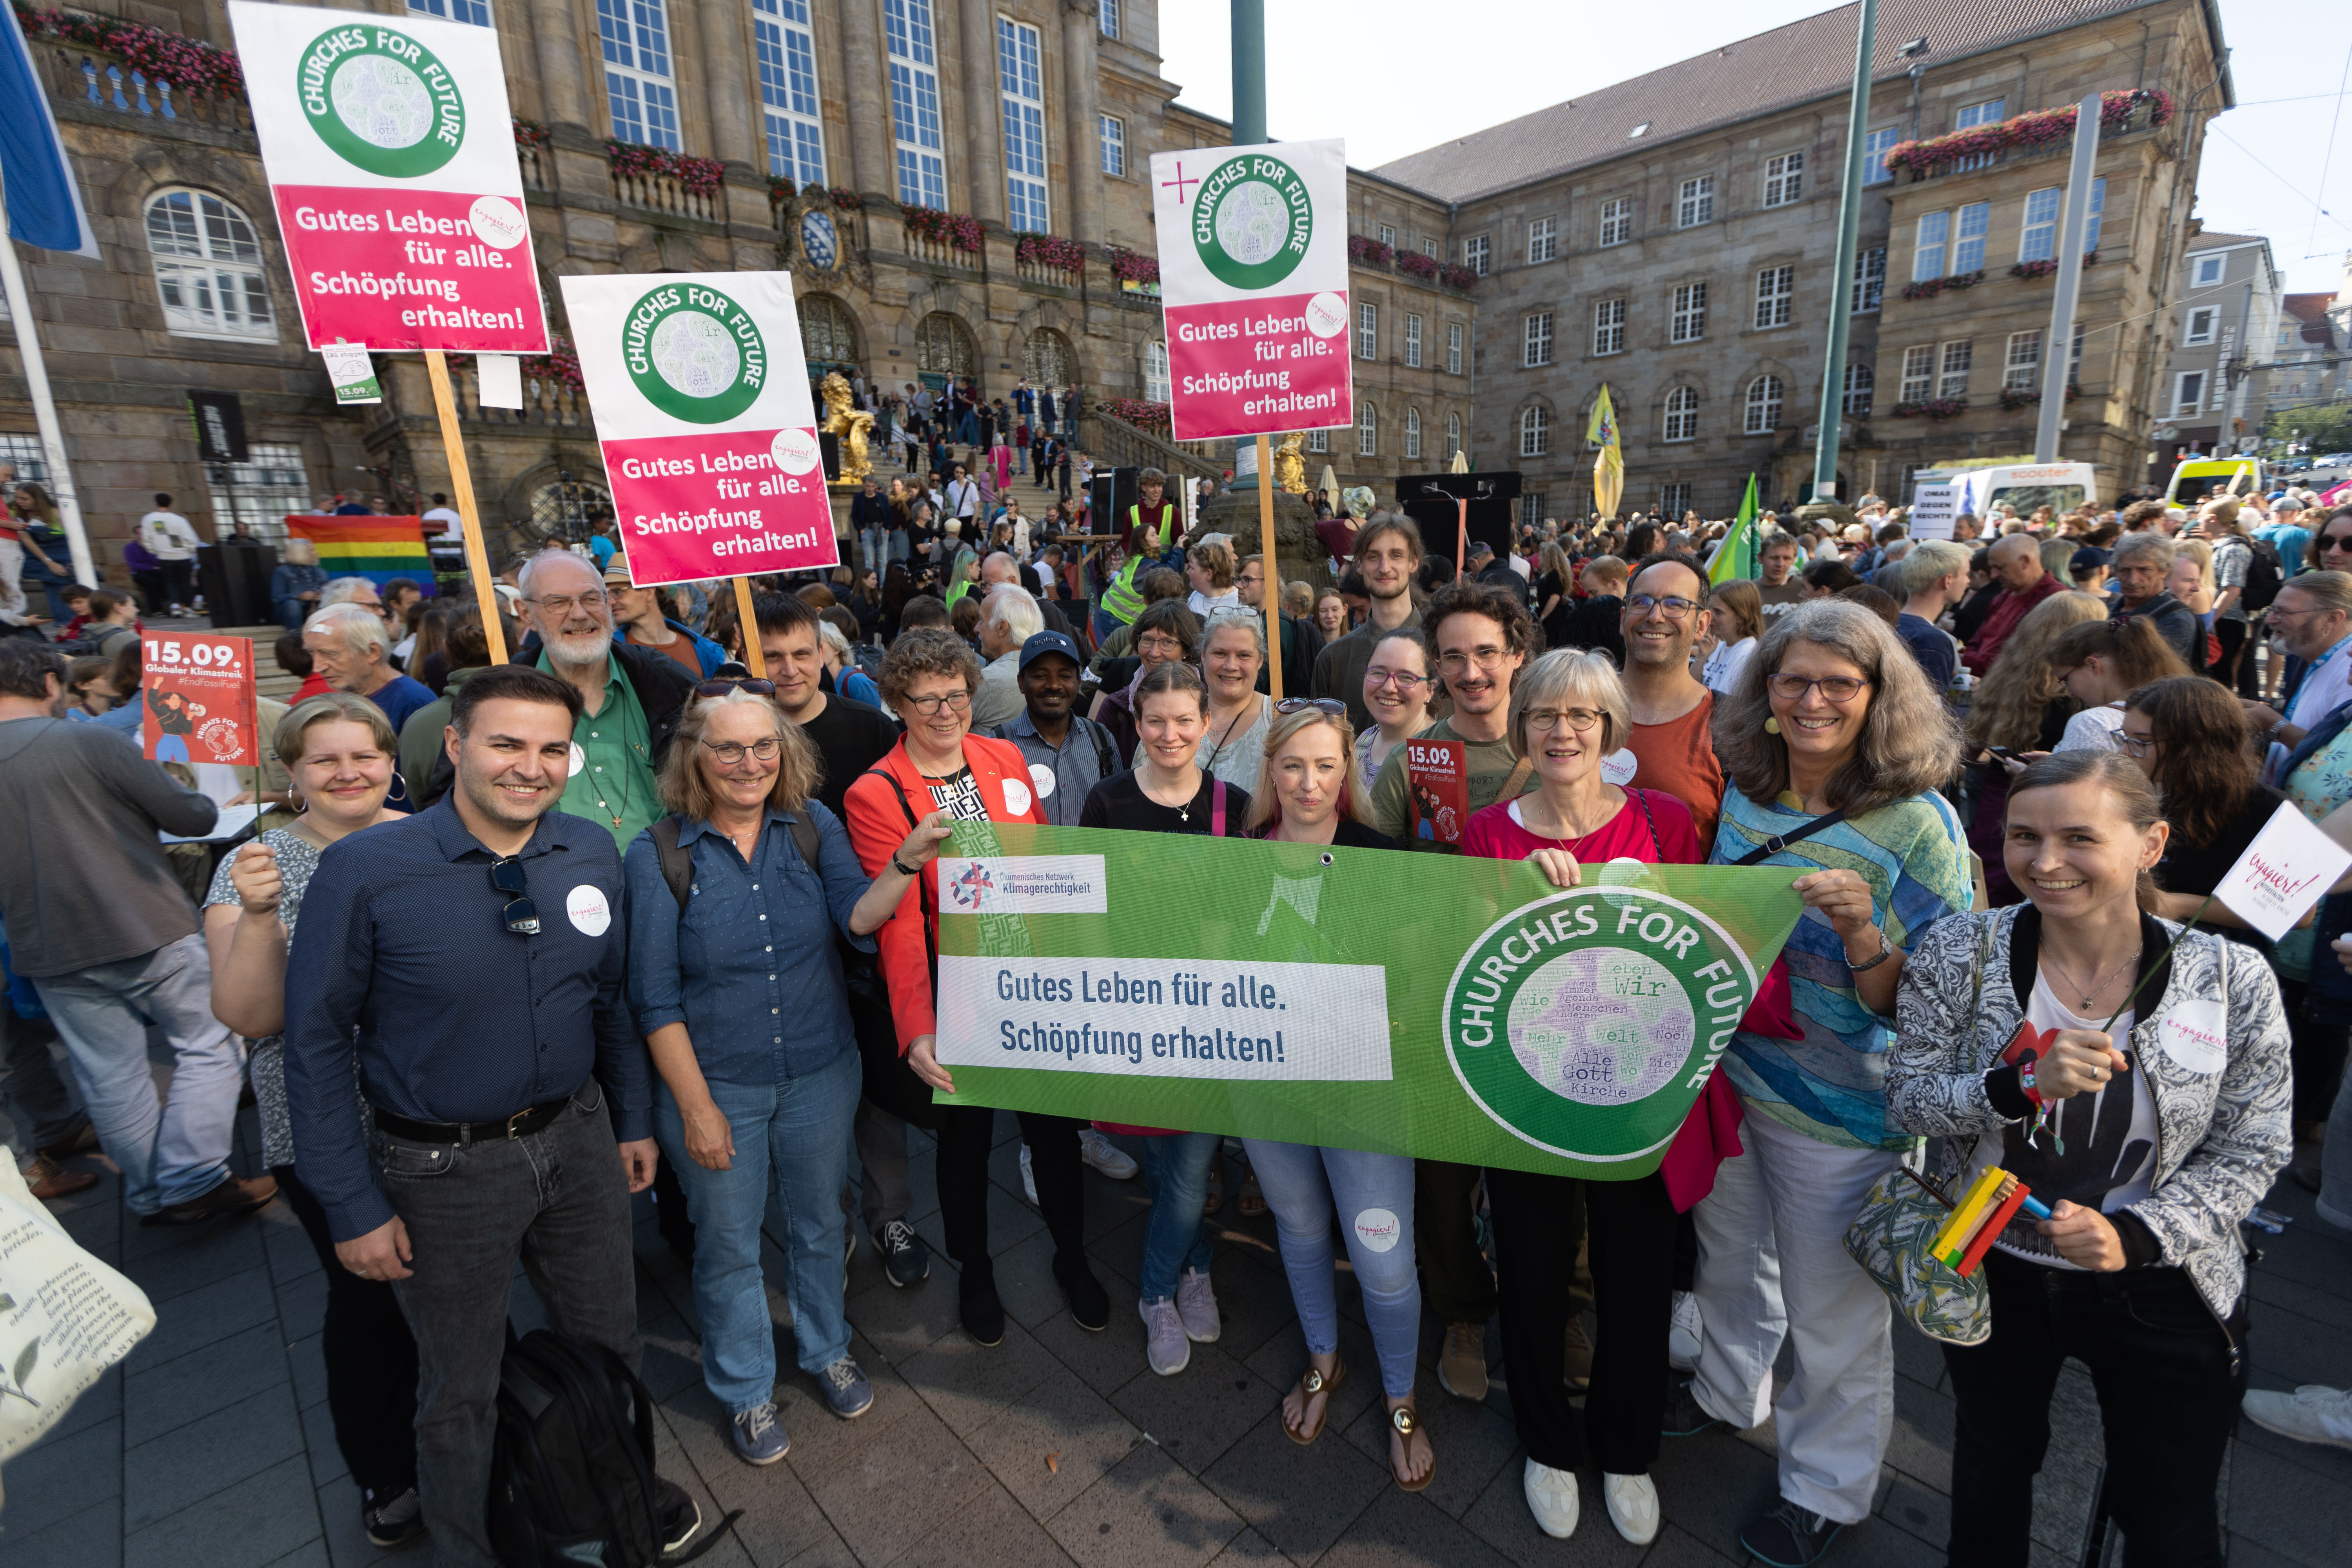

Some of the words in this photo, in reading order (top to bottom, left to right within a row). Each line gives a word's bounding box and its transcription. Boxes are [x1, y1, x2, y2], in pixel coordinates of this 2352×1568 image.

[304, 29, 367, 115] CHURCHES
[377, 31, 421, 64] FOR
[423, 63, 461, 147] FUTURE
[1197, 160, 1247, 244] CHURCHES
[1253, 158, 1287, 185] FOR
[1285, 180, 1309, 255] FUTURE
[1256, 195, 1276, 205] Wir
[296, 207, 379, 231] Gutes
[386, 210, 472, 236] Leben
[475, 208, 522, 233] engagiert!
[404, 240, 446, 265] für
[456, 244, 512, 268] alle.
[310, 271, 460, 302] Schöpfung
[402, 304, 524, 329] erhalten!
[1312, 302, 1344, 325] engagiert!
[628, 288, 681, 374] CHURCHES
[688, 288, 728, 316] FOR
[730, 313, 764, 388] FUTURE
[696, 326, 720, 337] Wir
[1179, 321, 1238, 342] Gutes
[1245, 315, 1305, 337] Leben
[1254, 341, 1285, 362] für
[1290, 338, 1333, 358] alle.
[1183, 369, 1290, 394] Schöpfung
[1243, 388, 1337, 416] erhalten!
[775, 444, 815, 457] engagiert!
[622, 458, 695, 479] Gutes
[701, 450, 773, 474] Leben
[2011, 468, 2072, 479] scouter
[716, 479, 752, 499] für
[759, 475, 808, 497] alle.
[634, 508, 763, 535] Schöpfung
[712, 527, 818, 557] erhalten!
[145, 641, 241, 668] 15.09.
[145, 664, 188, 675] Globaler
[191, 667, 243, 679] Klimastreik
[197, 718, 220, 739] FRIDAYS
[222, 718, 238, 729] FOR
[215, 747, 245, 761] FUTURE
[1408, 746, 1454, 766] 15.09.
[1425, 773, 1456, 783] #EndFossilFuels
[1430, 766, 1455, 775] Klimastreik
[1436, 806, 1447, 823] FRIDAYS
[1445, 830, 1460, 841] FUTURE
[1000, 871, 1044, 881] Ökumenisches
[1046, 873, 1074, 881] Netzwerk
[2246, 853, 2320, 898] engagiert!
[1003, 883, 1091, 896] Klimagerechtigkeit
[2259, 882, 2285, 902] MITGESTALTEN
[572, 898, 604, 919] engagiert!
[1571, 954, 1597, 963] Einig
[1604, 963, 1652, 975] Leben
[997, 969, 1073, 1002] Gutes
[1082, 971, 1162, 1005] Leben
[1171, 973, 1213, 1007] für
[1221, 975, 1287, 1011] alle.
[1614, 975, 1666, 996] Wir
[1462, 904, 1599, 1047] CHURCHES
[1617, 905, 1700, 960] FOR
[1686, 958, 1743, 1091] FUTURE
[1519, 994, 1549, 1005] Wie
[1560, 994, 1599, 1003] Agenda
[1568, 1004, 1628, 1014] Menschen
[1001, 1020, 1142, 1064] Schöpfung
[1152, 1025, 1285, 1063] erhalten!
[1528, 1033, 1566, 1044] Mehr
[1596, 1028, 1639, 1044] Welt
[1655, 1030, 1691, 1041] Noch
[1542, 1050, 1559, 1059] Du
[1573, 1053, 1612, 1066] Alle
[1576, 1046, 1608, 1054] Umwelt
[1563, 1065, 1613, 1082] Gott
[1621, 1065, 1637, 1075] Wo
[1650, 1058, 1679, 1068] Ziel
[1571, 1083, 1627, 1098] Kirche
[2, 1229, 18, 1242] are
[21, 1220, 34, 1230] on
[1358, 1219, 1395, 1237] engagiert!
[4, 1230, 43, 1259] petioles,
[9, 1296, 38, 1327] obovate,
[37, 1261, 83, 1299] pubescent,
[42, 1289, 59, 1309] dark
[61, 1270, 91, 1293] green,
[47, 1299, 67, 1319] Some
[68, 1277, 97, 1303] plants
[42, 1319, 64, 1347] contain
[64, 1285, 104, 1323] poisonous
[58, 1314, 84, 1346] alkaloids
[85, 1305, 95, 1315] in
[97, 1292, 112, 1307] the
[53, 1347, 73, 1369] stems
[71, 1330, 82, 1348] and
[82, 1310, 107, 1334] leaves
[108, 1300, 119, 1312] in
[75, 1342, 89, 1362] early
[87, 1308, 127, 1348] flowering
